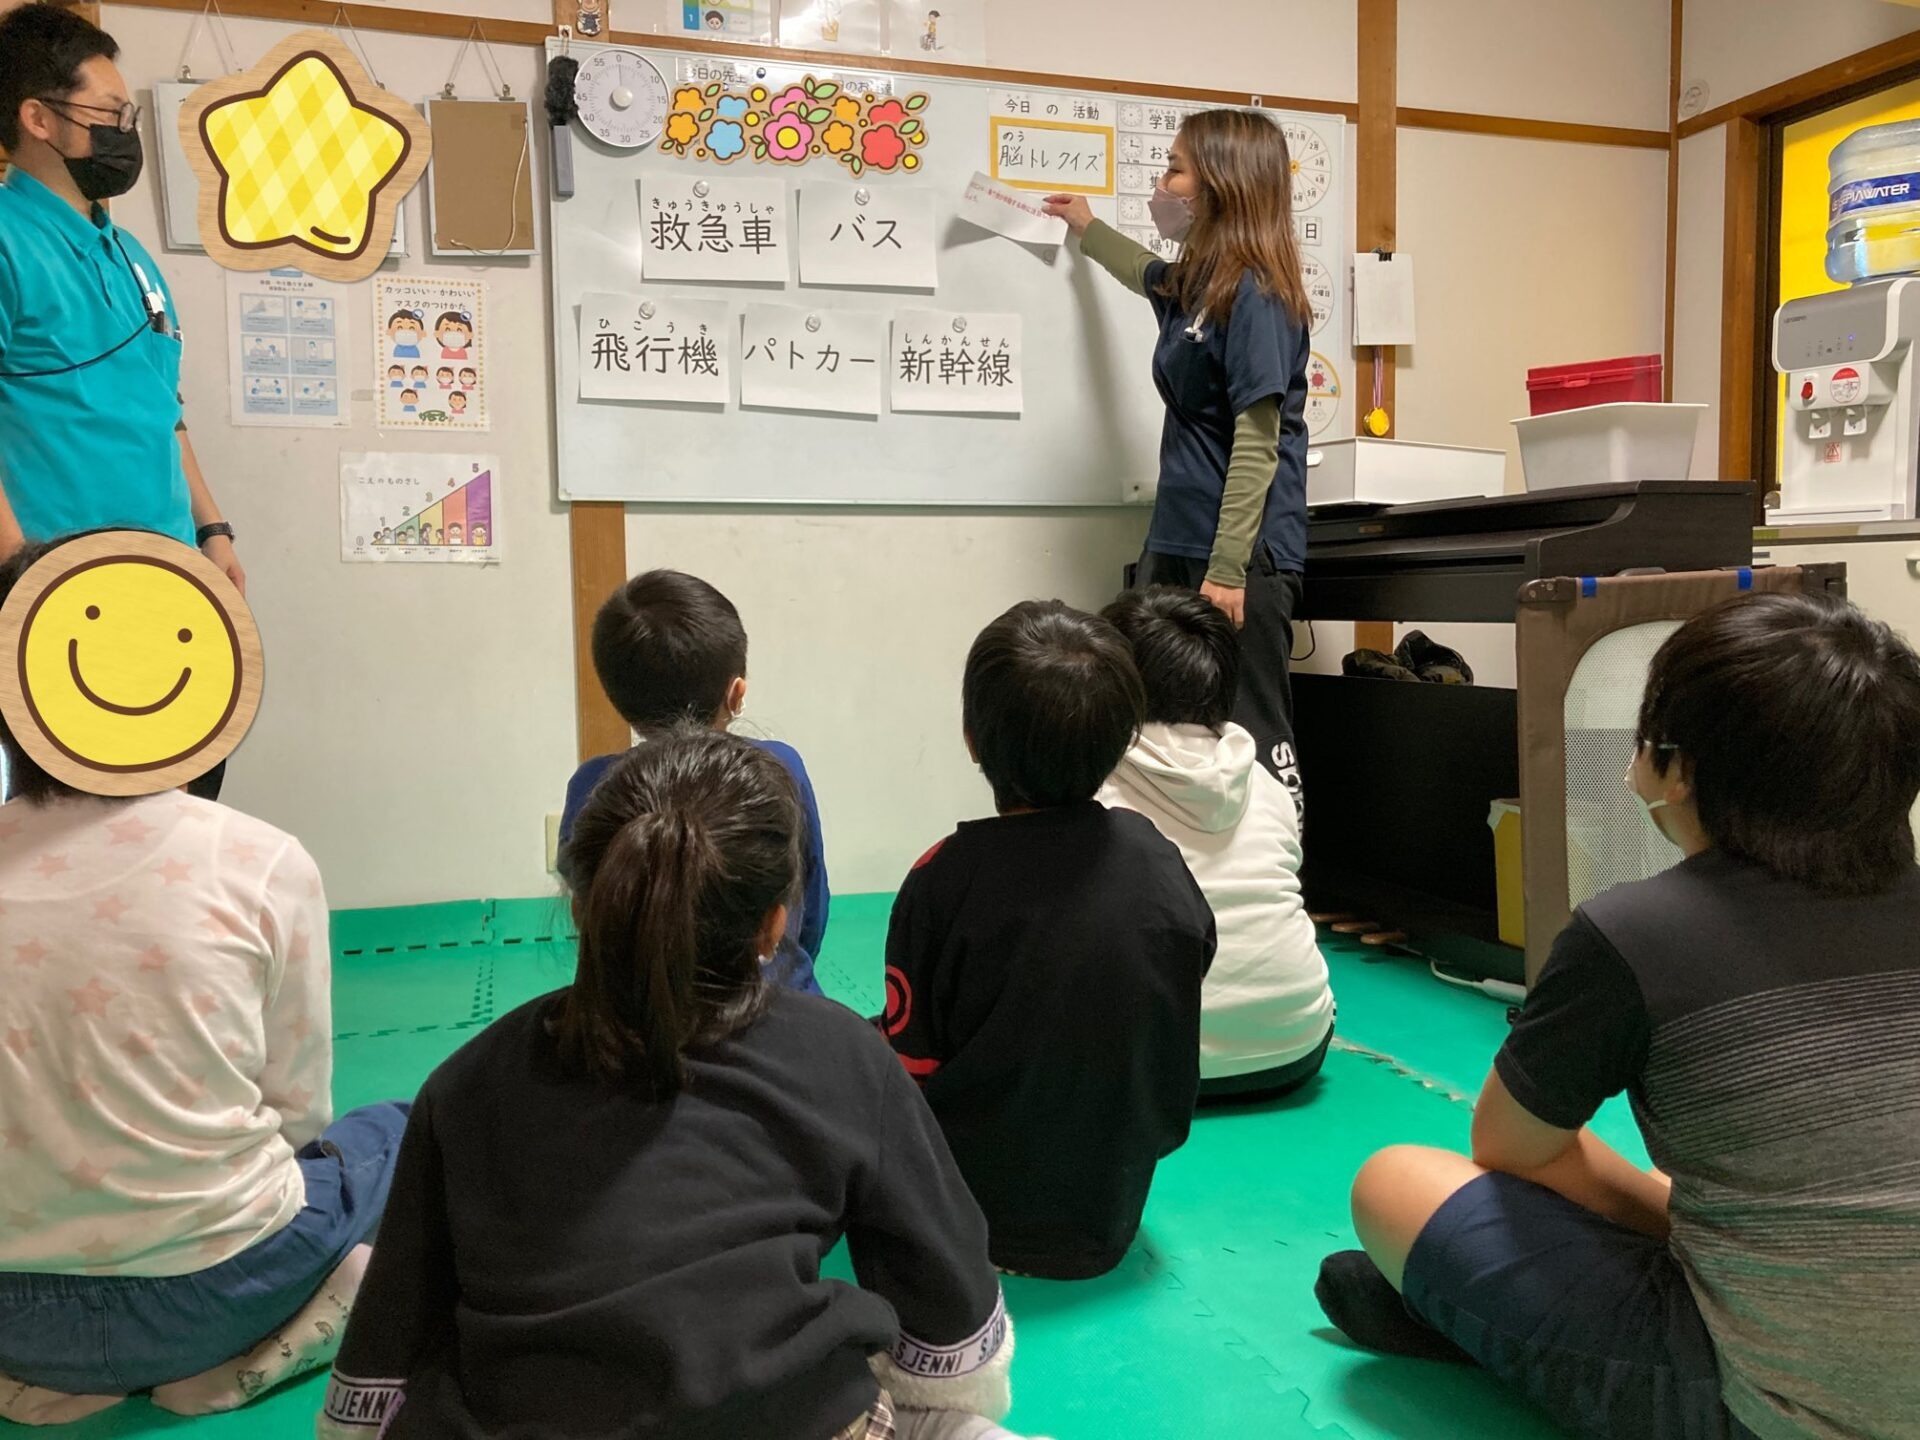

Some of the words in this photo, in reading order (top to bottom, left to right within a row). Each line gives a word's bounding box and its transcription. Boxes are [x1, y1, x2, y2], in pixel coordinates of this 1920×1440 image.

[594, 58, 605, 66] 55
[615, 54, 622, 62] 0
[636, 60, 643, 68] 5
[580, 73, 591, 81] 50
[651, 76, 660, 84] 10
[657, 96, 667, 104] 15
[1004, 98, 1030, 114] 今日
[1046, 104, 1059, 115] の
[1073, 105, 1100, 121] 活動
[584, 114, 595, 122] 40
[1149, 114, 1176, 130] 学習
[600, 129, 610, 137] 35
[620, 135, 631, 143] 30
[640, 130, 650, 138] 25
[1002, 130, 1025, 142] のう
[652, 197, 775, 215] きゅうきゅうしゃ
[649, 211, 777, 255] 救急車
[829, 213, 902, 249] バス
[1306, 223, 1317, 239] 日
[394, 300, 467, 311] マスクのつけかた
[598, 318, 708, 336] ひこうき
[904, 332, 1010, 349] しんかんせん
[591, 332, 719, 377] 飛行機
[744, 337, 875, 373] パトカー
[899, 345, 1014, 387] 新幹線
[471, 462, 480, 474] 5
[447, 477, 456, 488] 4
[402, 505, 411, 517] 2
[379, 516, 386, 527] 1
